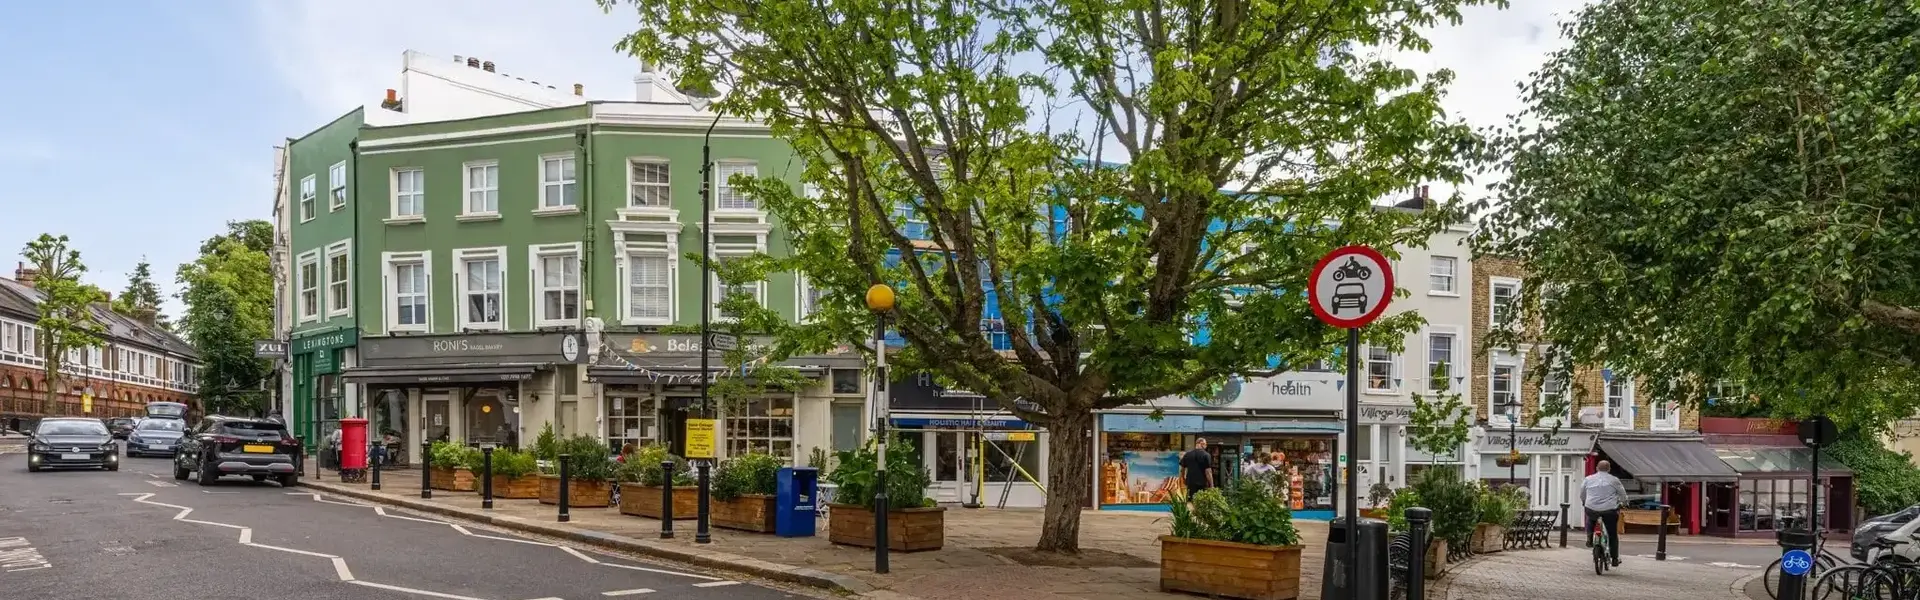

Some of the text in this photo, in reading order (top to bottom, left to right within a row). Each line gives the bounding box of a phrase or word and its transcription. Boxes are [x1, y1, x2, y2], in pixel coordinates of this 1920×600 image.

[258, 343, 285, 352] XUL
[303, 334, 344, 350] LEXINGTONS
[433, 339, 468, 351] RONI'S
[1361, 407, 1394, 421] Village
[1518, 436, 1533, 445] Vet
